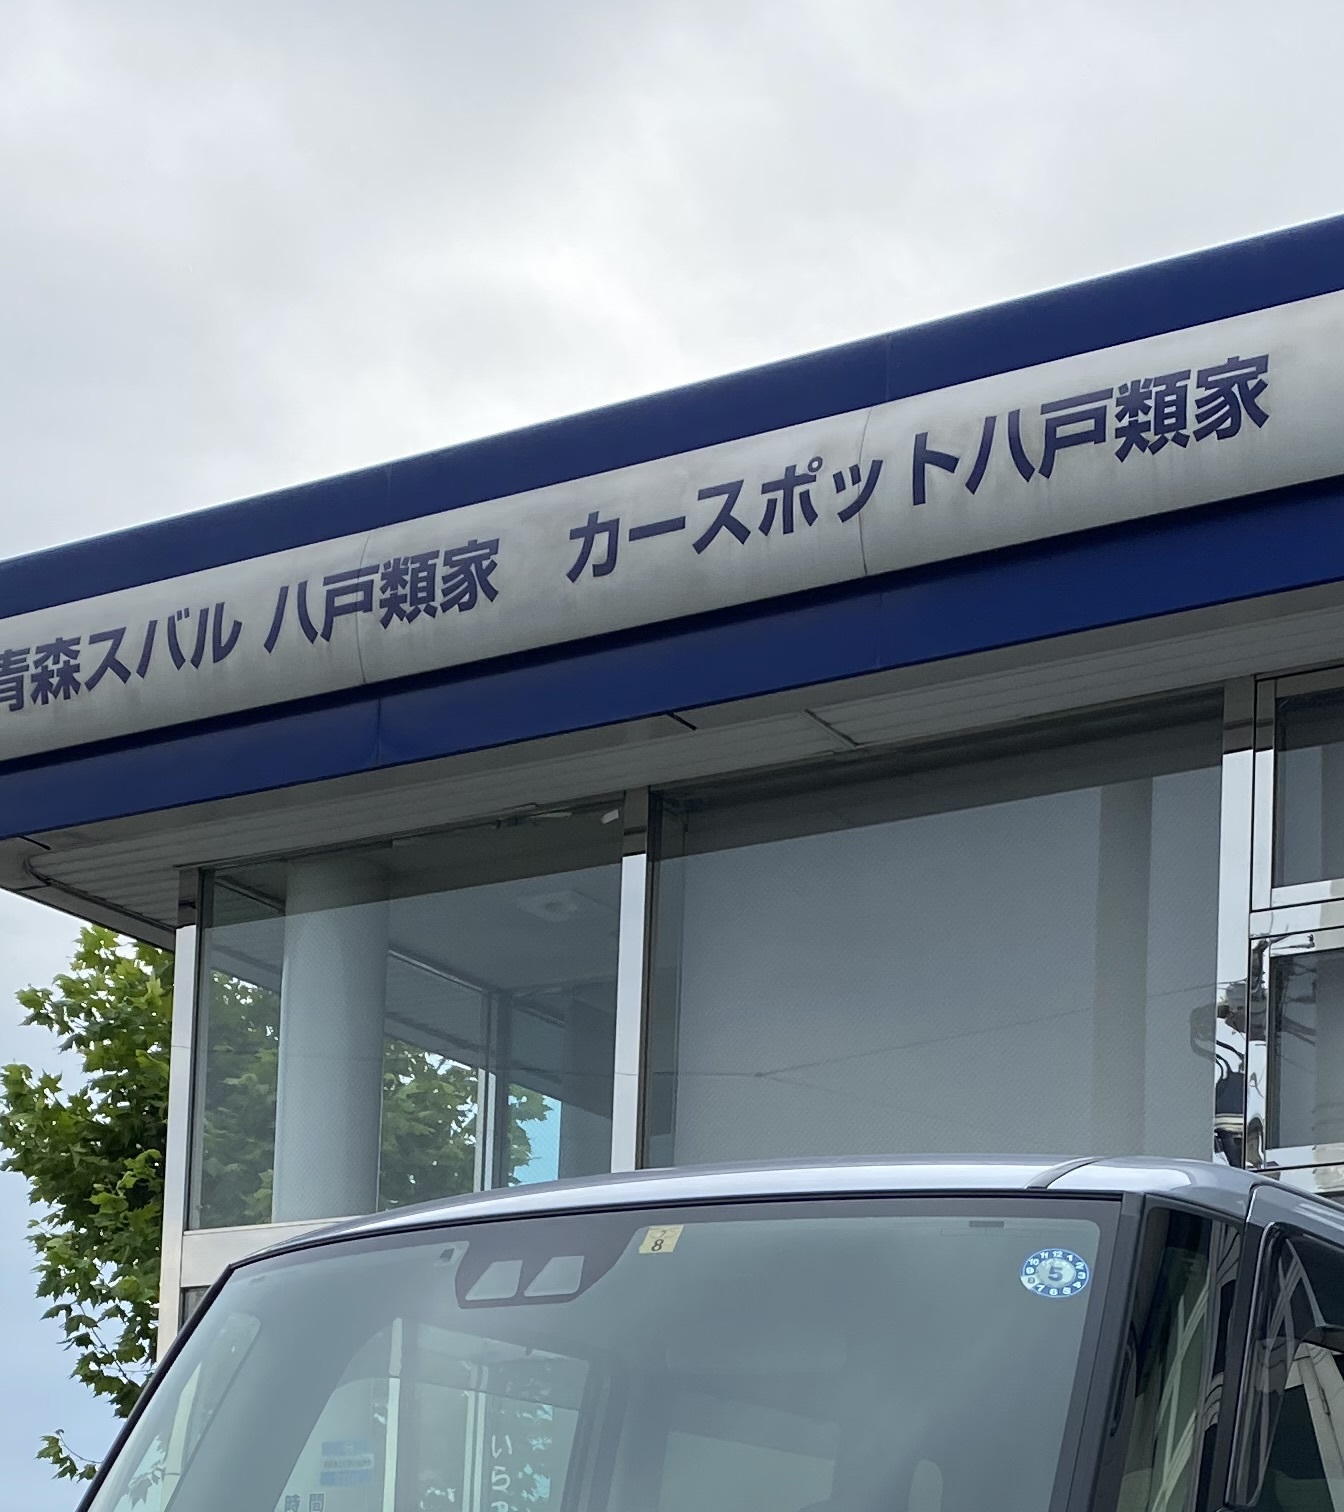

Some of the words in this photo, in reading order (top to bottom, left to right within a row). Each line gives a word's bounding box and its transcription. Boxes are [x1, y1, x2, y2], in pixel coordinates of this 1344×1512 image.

[262, 537, 501, 654] 八戸類家
[565, 352, 1272, 583] カースポット八戸類家
[650, 1238, 665, 1252] 8
[1040, 1251, 1049, 1259] 11
[1052, 1250, 1063, 1258] 12
[1029, 1258, 1040, 1266] 10
[1076, 1261, 1085, 1270] 2
[1047, 1265, 1064, 1282] 5
